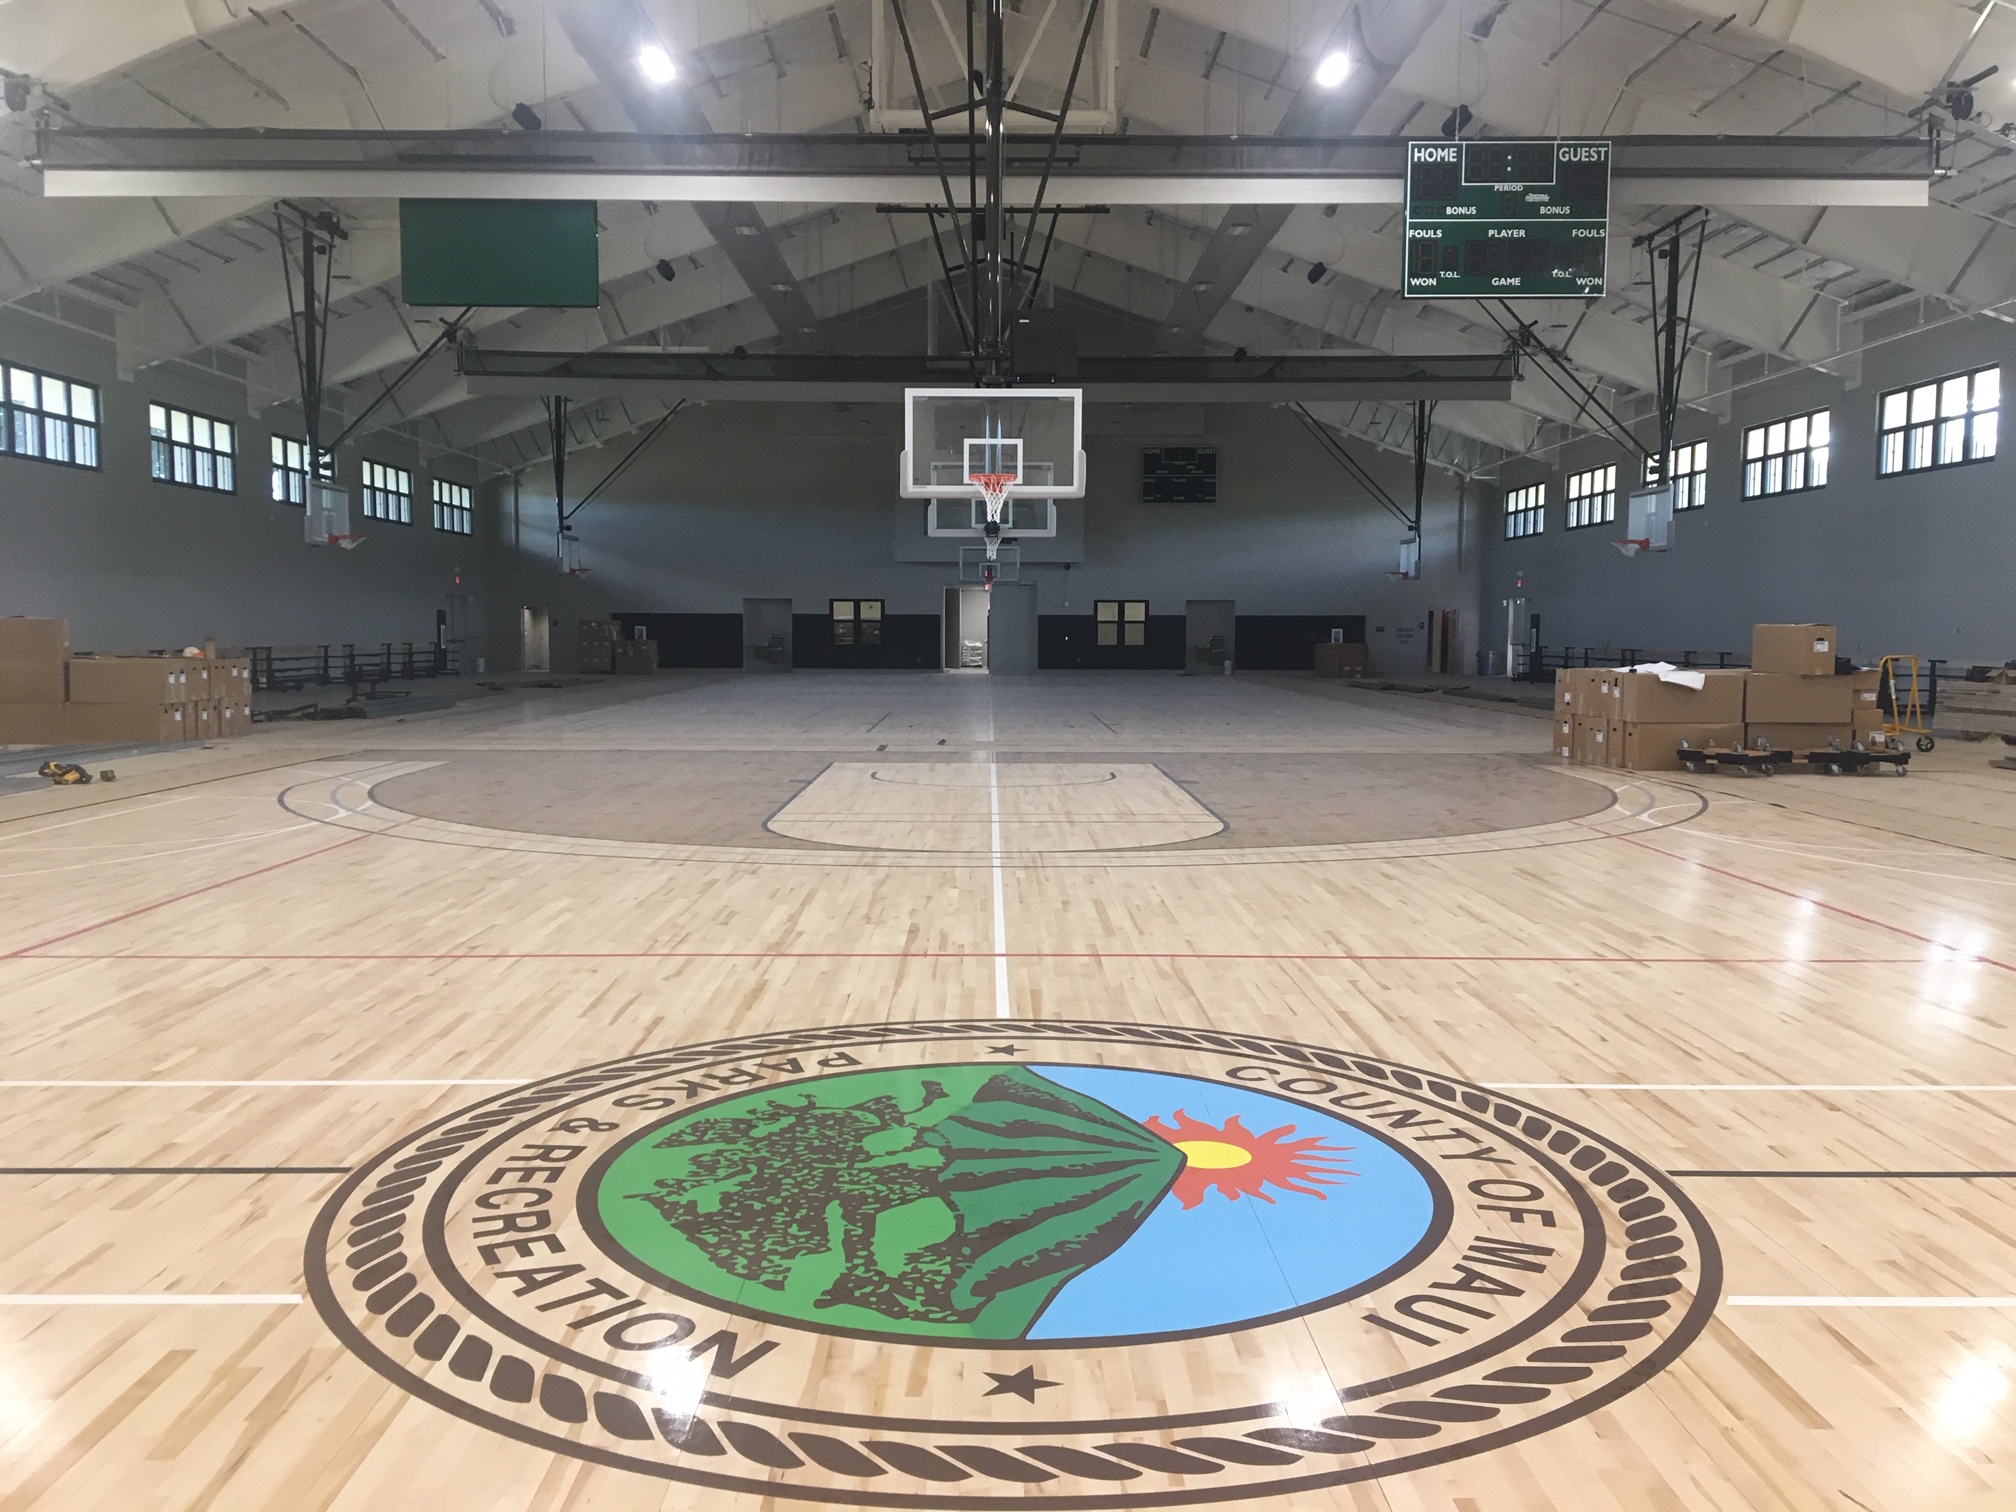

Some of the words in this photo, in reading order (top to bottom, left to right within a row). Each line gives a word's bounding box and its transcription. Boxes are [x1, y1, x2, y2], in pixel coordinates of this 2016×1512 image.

[1413, 147, 1458, 162] HOME
[1558, 147, 1608, 162] GUEST
[1494, 184, 1524, 192] PERIOD
[1446, 206, 1477, 215] BONUS
[1539, 206, 1571, 215] BONUS
[1409, 229, 1443, 238] FOULS
[1488, 229, 1526, 238] PLAYER
[1572, 229, 1606, 238] FOULS
[1410, 277, 1437, 286] WON
[1491, 277, 1521, 286] GAME
[1576, 277, 1603, 286] WON
[611, 1051, 862, 1111] PARKS
[1225, 1065, 1517, 1166] COUNTY
[546, 1116, 620, 1135] &
[1467, 1178, 1557, 1228] OF
[471, 1143, 781, 1380] RECREATION
[1360, 1235, 1556, 1348] MAUI
